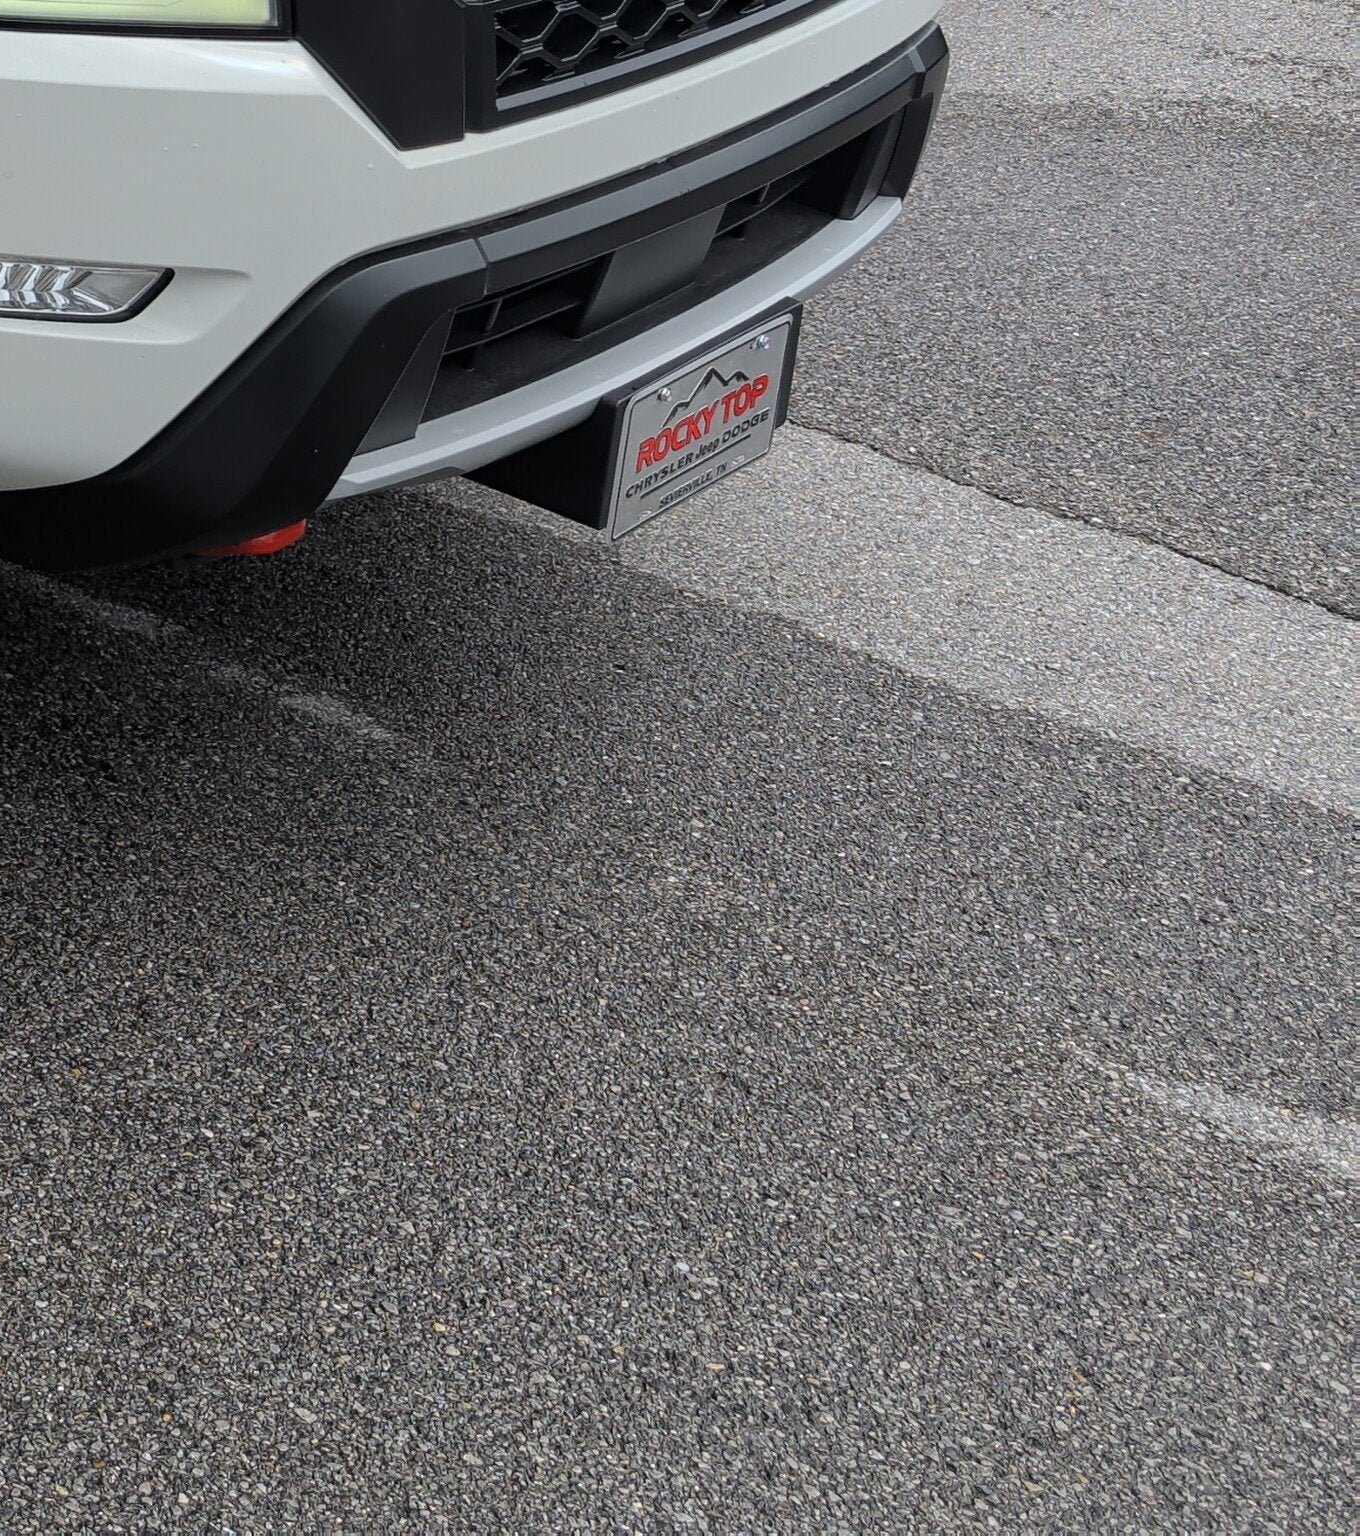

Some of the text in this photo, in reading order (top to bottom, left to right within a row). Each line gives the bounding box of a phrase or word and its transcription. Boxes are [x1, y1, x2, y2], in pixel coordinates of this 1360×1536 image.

[625, 407, 770, 499] CHRYSLER Jeep DODGE
[636, 374, 770, 473] ROCKY TOP
